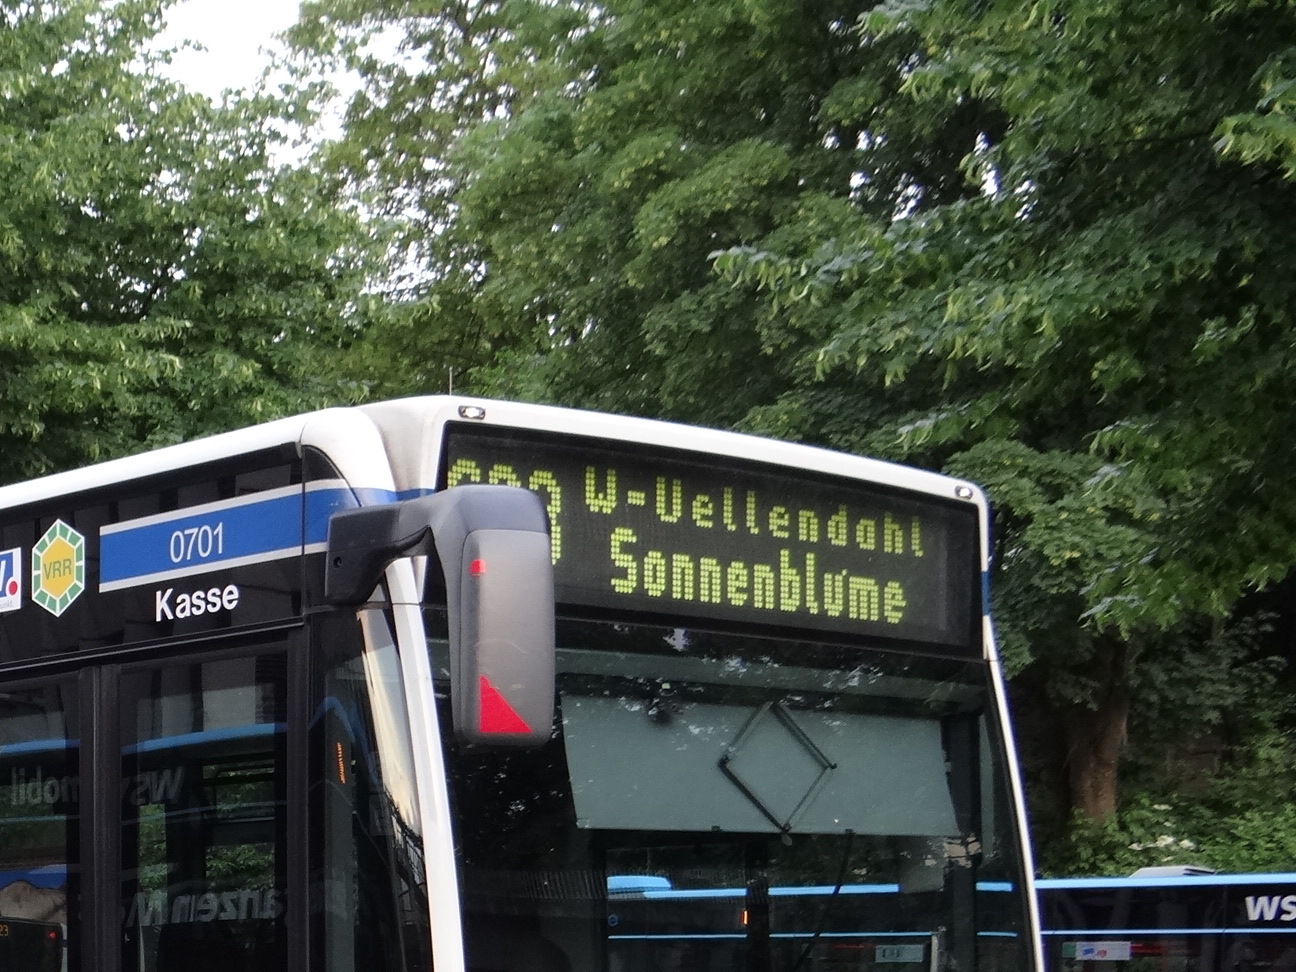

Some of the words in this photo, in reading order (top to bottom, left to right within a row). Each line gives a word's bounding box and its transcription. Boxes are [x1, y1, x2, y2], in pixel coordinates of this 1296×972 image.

[170, 522, 223, 563] 0701
[43, 558, 72, 579] VRR
[610, 527, 907, 624] Sonnenblume
[155, 584, 240, 622] Kasse
